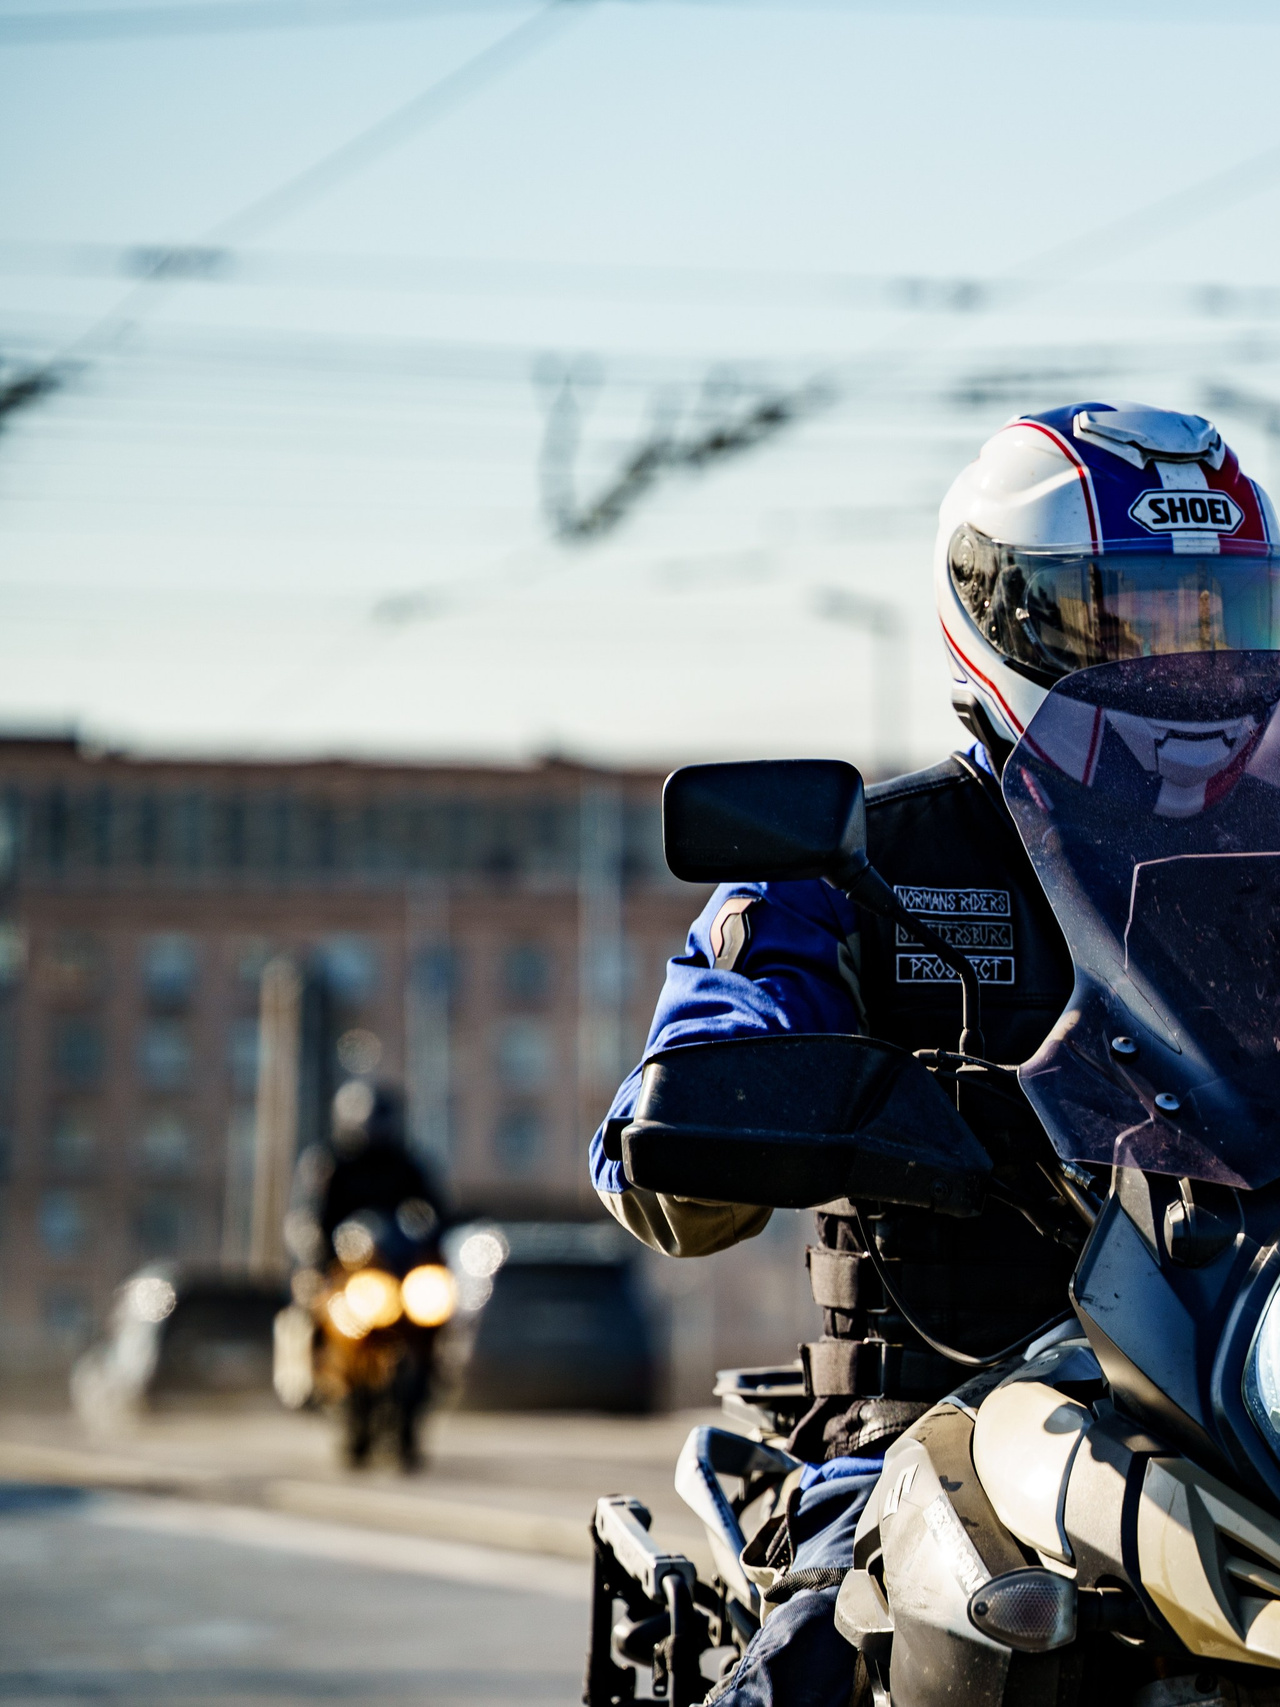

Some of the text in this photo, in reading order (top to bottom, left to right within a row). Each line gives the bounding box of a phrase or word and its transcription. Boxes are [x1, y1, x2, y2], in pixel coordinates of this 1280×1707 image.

[1148, 497, 1233, 526] SHOEI
[897, 889, 1007, 912] NORMANS RIDERS
[909, 957, 1003, 980] PROSECT
